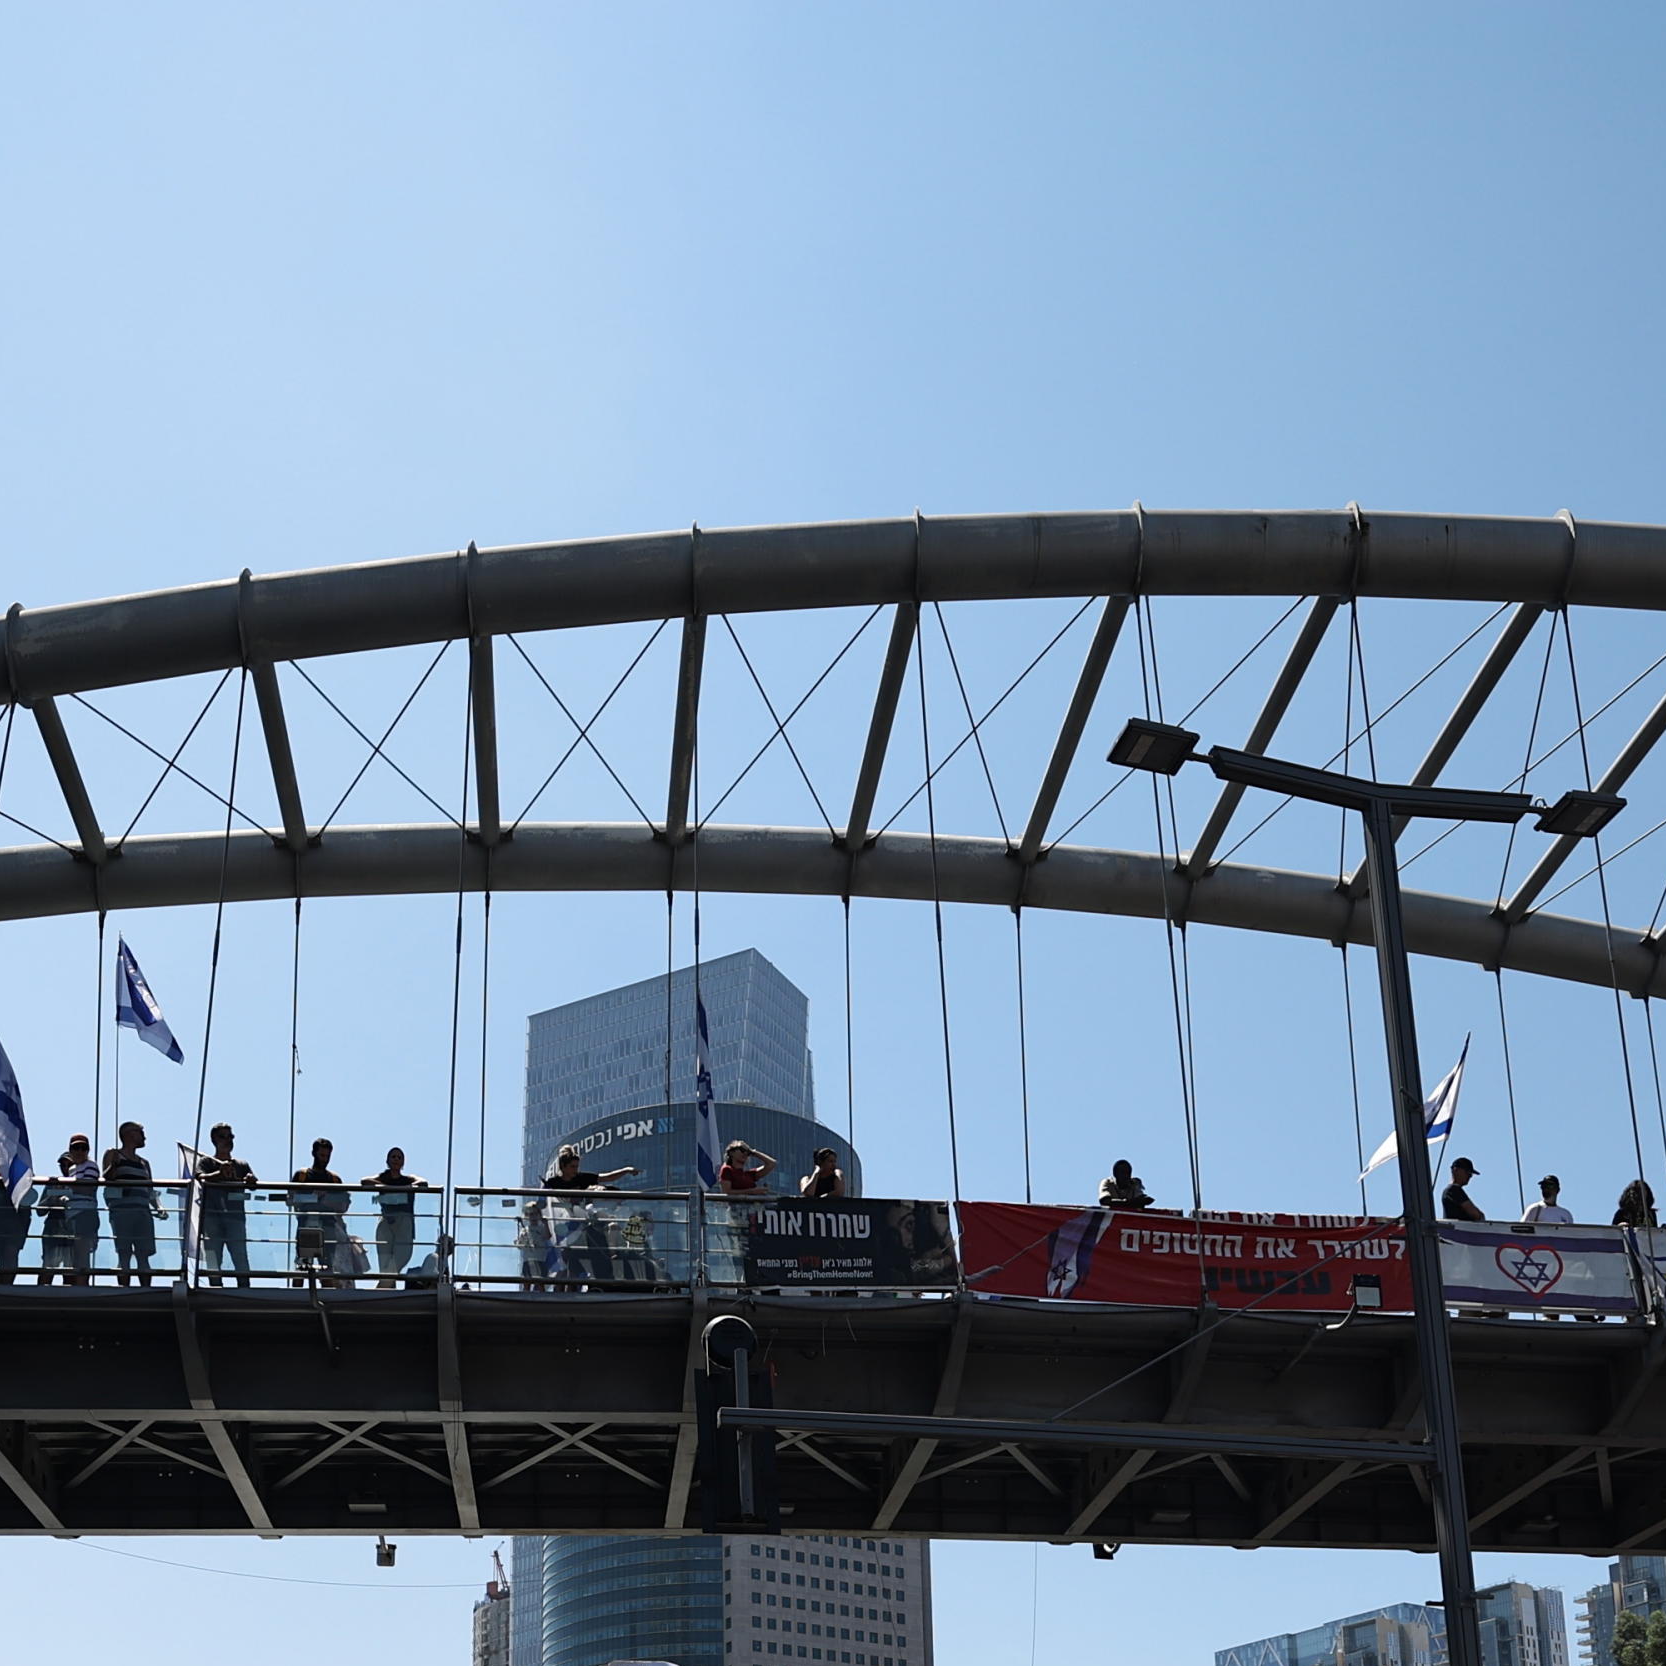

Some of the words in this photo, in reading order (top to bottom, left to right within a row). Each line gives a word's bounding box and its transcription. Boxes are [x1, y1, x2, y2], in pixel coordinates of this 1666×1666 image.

[616, 1119, 654, 1140] אפי
[808, 1211, 871, 1239] שחררו
[1120, 1228, 1243, 1259] החטופים
[1254, 1237, 1297, 1259] את
[1307, 1238, 1407, 1261] לשחרר
[1203, 1267, 1331, 1295] עכשיו
